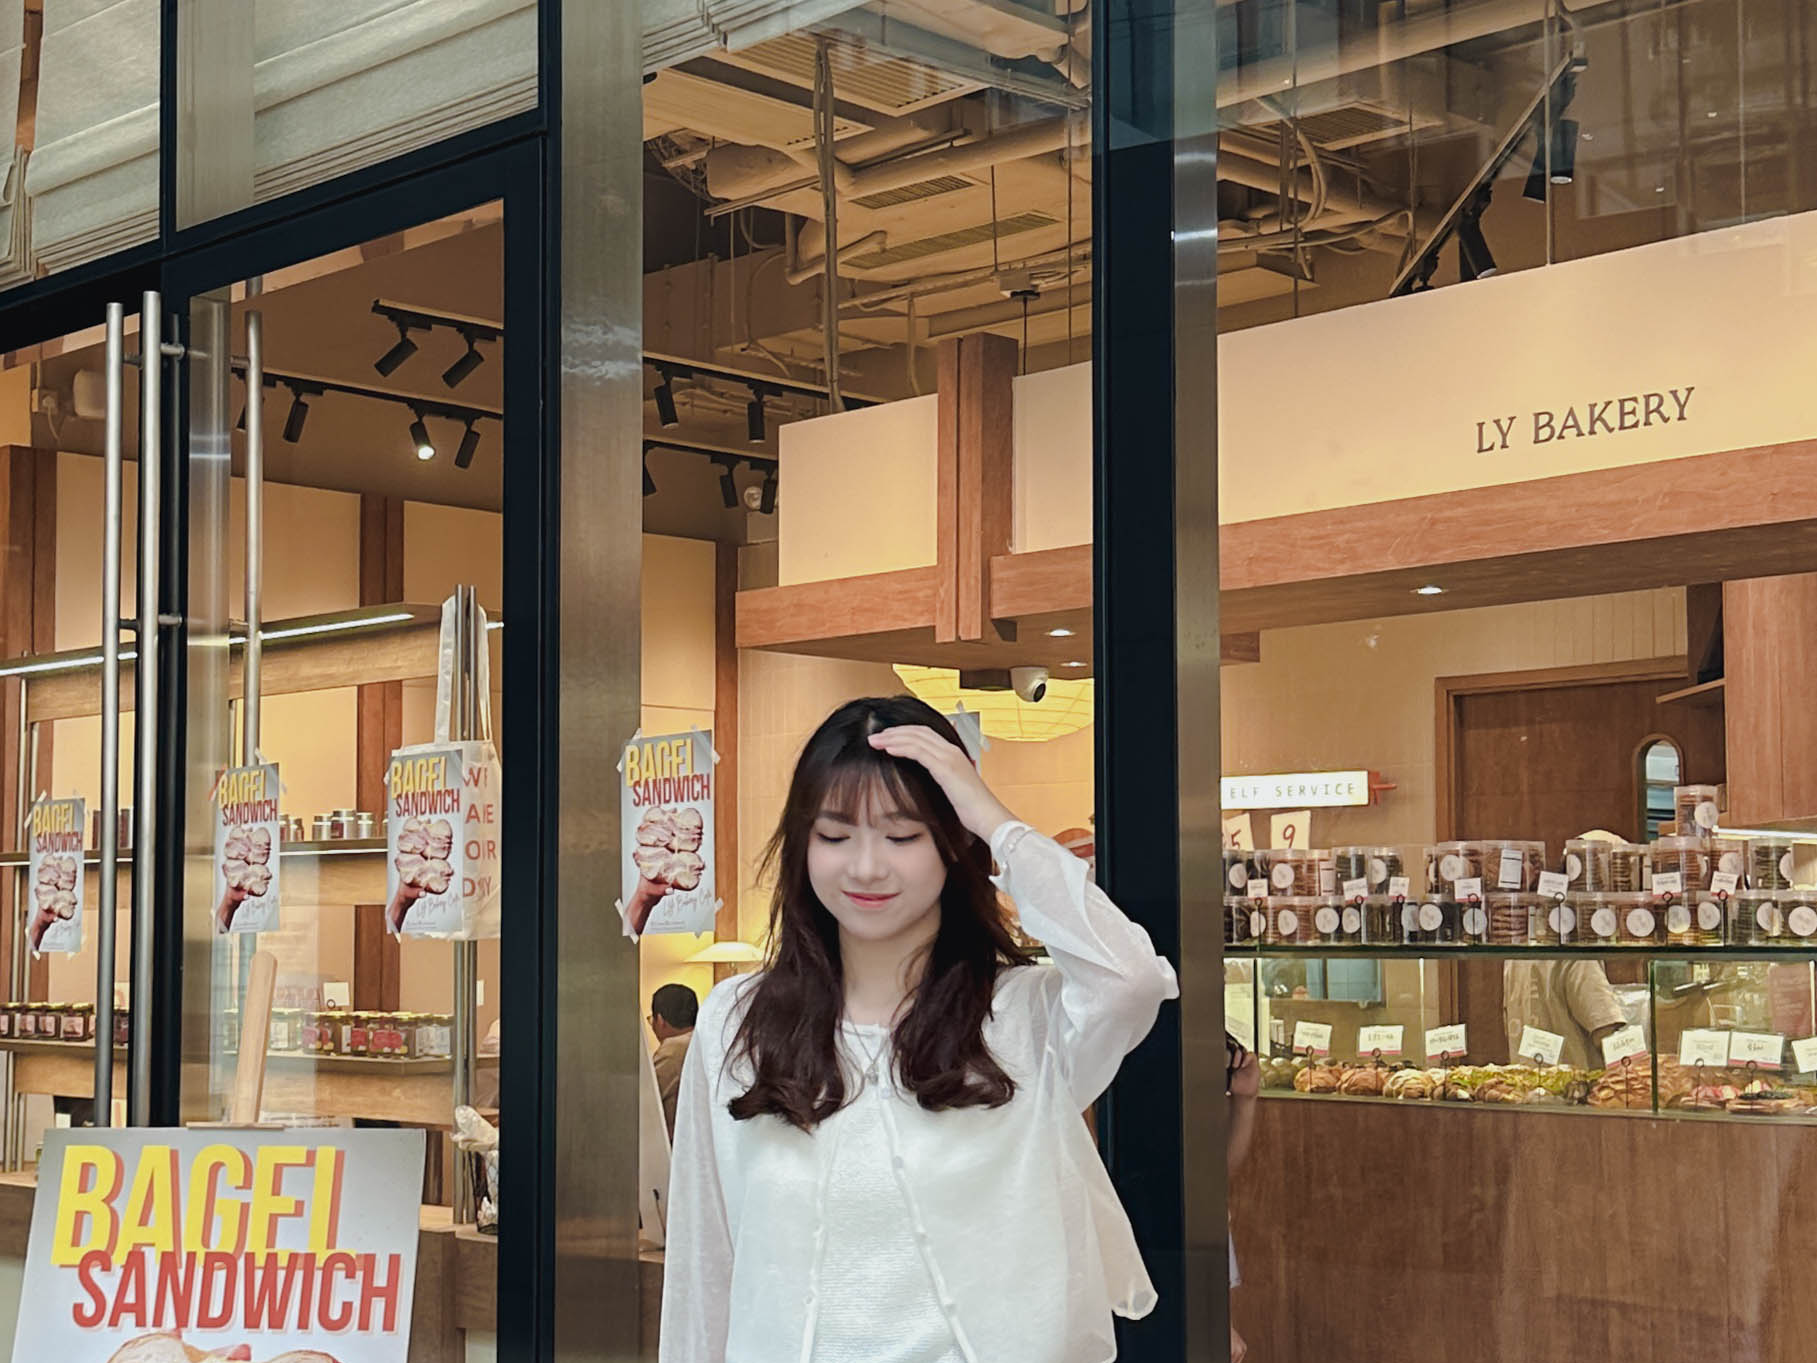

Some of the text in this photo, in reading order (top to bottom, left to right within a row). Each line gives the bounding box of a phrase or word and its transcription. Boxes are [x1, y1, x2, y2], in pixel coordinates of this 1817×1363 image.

[1475, 386, 1695, 454] LY BAKERY
[395, 788, 461, 818] SANDWICH
[632, 772, 711, 807] SANDWICH
[1229, 782, 1355, 800] ELF SERVICE
[222, 797, 278, 826] SANDWICH
[51, 1143, 363, 1269] BAGEL
[72, 1249, 402, 1333] SANDWICH
